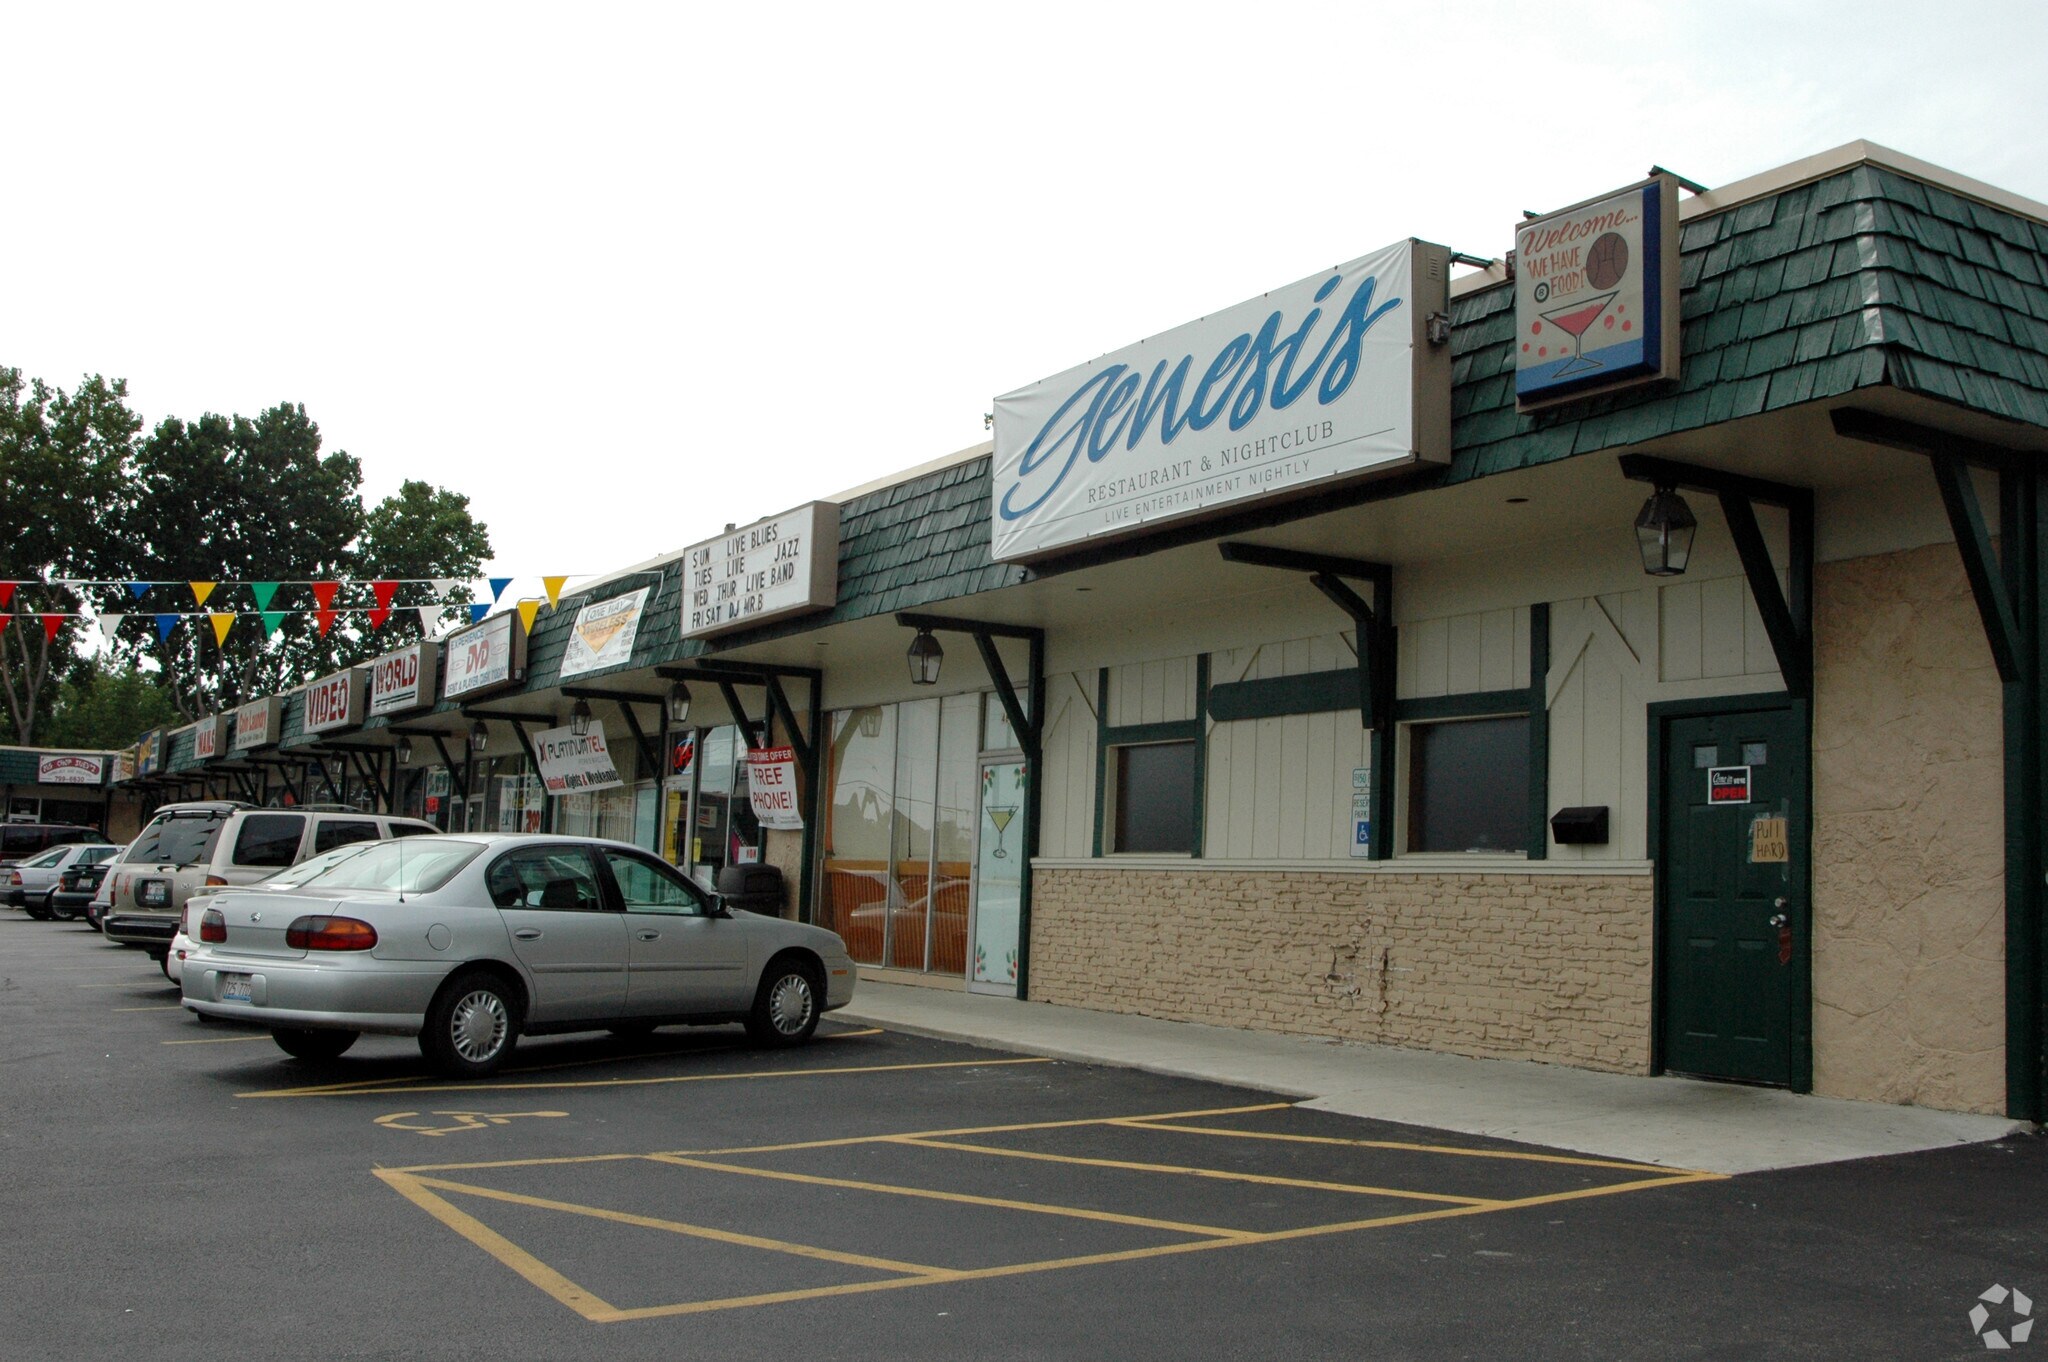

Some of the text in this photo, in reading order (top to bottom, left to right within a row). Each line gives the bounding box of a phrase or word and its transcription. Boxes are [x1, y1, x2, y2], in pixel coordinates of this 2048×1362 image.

[1551, 246, 1581, 273] HAVE
[1087, 420, 1334, 504] RESTAURANT & NIGHTCLUB
[1104, 459, 1311, 524] LIVE ENTERTAINMENT NIGHTLY
[693, 523, 778, 568] SUN LIVE BLUES
[694, 538, 800, 588] TUES LIVE JAZZ
[693, 562, 794, 609] WED THUR LIVE BAND
[589, 601, 624, 619] ONE WAY
[692, 608, 704, 629] FRI
[706, 605, 722, 626] SAT
[728, 601, 740, 619] DJ
[450, 627, 485, 650] EXPERIENCE
[466, 640, 489, 675] DVD
[376, 654, 418, 695] WORLD
[308, 678, 349, 727] VIDEO
[249, 703, 267, 732] Laundry
[198, 728, 216, 756] NAILS
[548, 736, 606, 759] PLATINUMTEL
[770, 749, 792, 760] OFFER
[754, 767, 783, 785] FREE
[753, 791, 793, 810] PHONE!
[1713, 786, 1747, 800] OPEN
[1756, 841, 1785, 860] HARD
